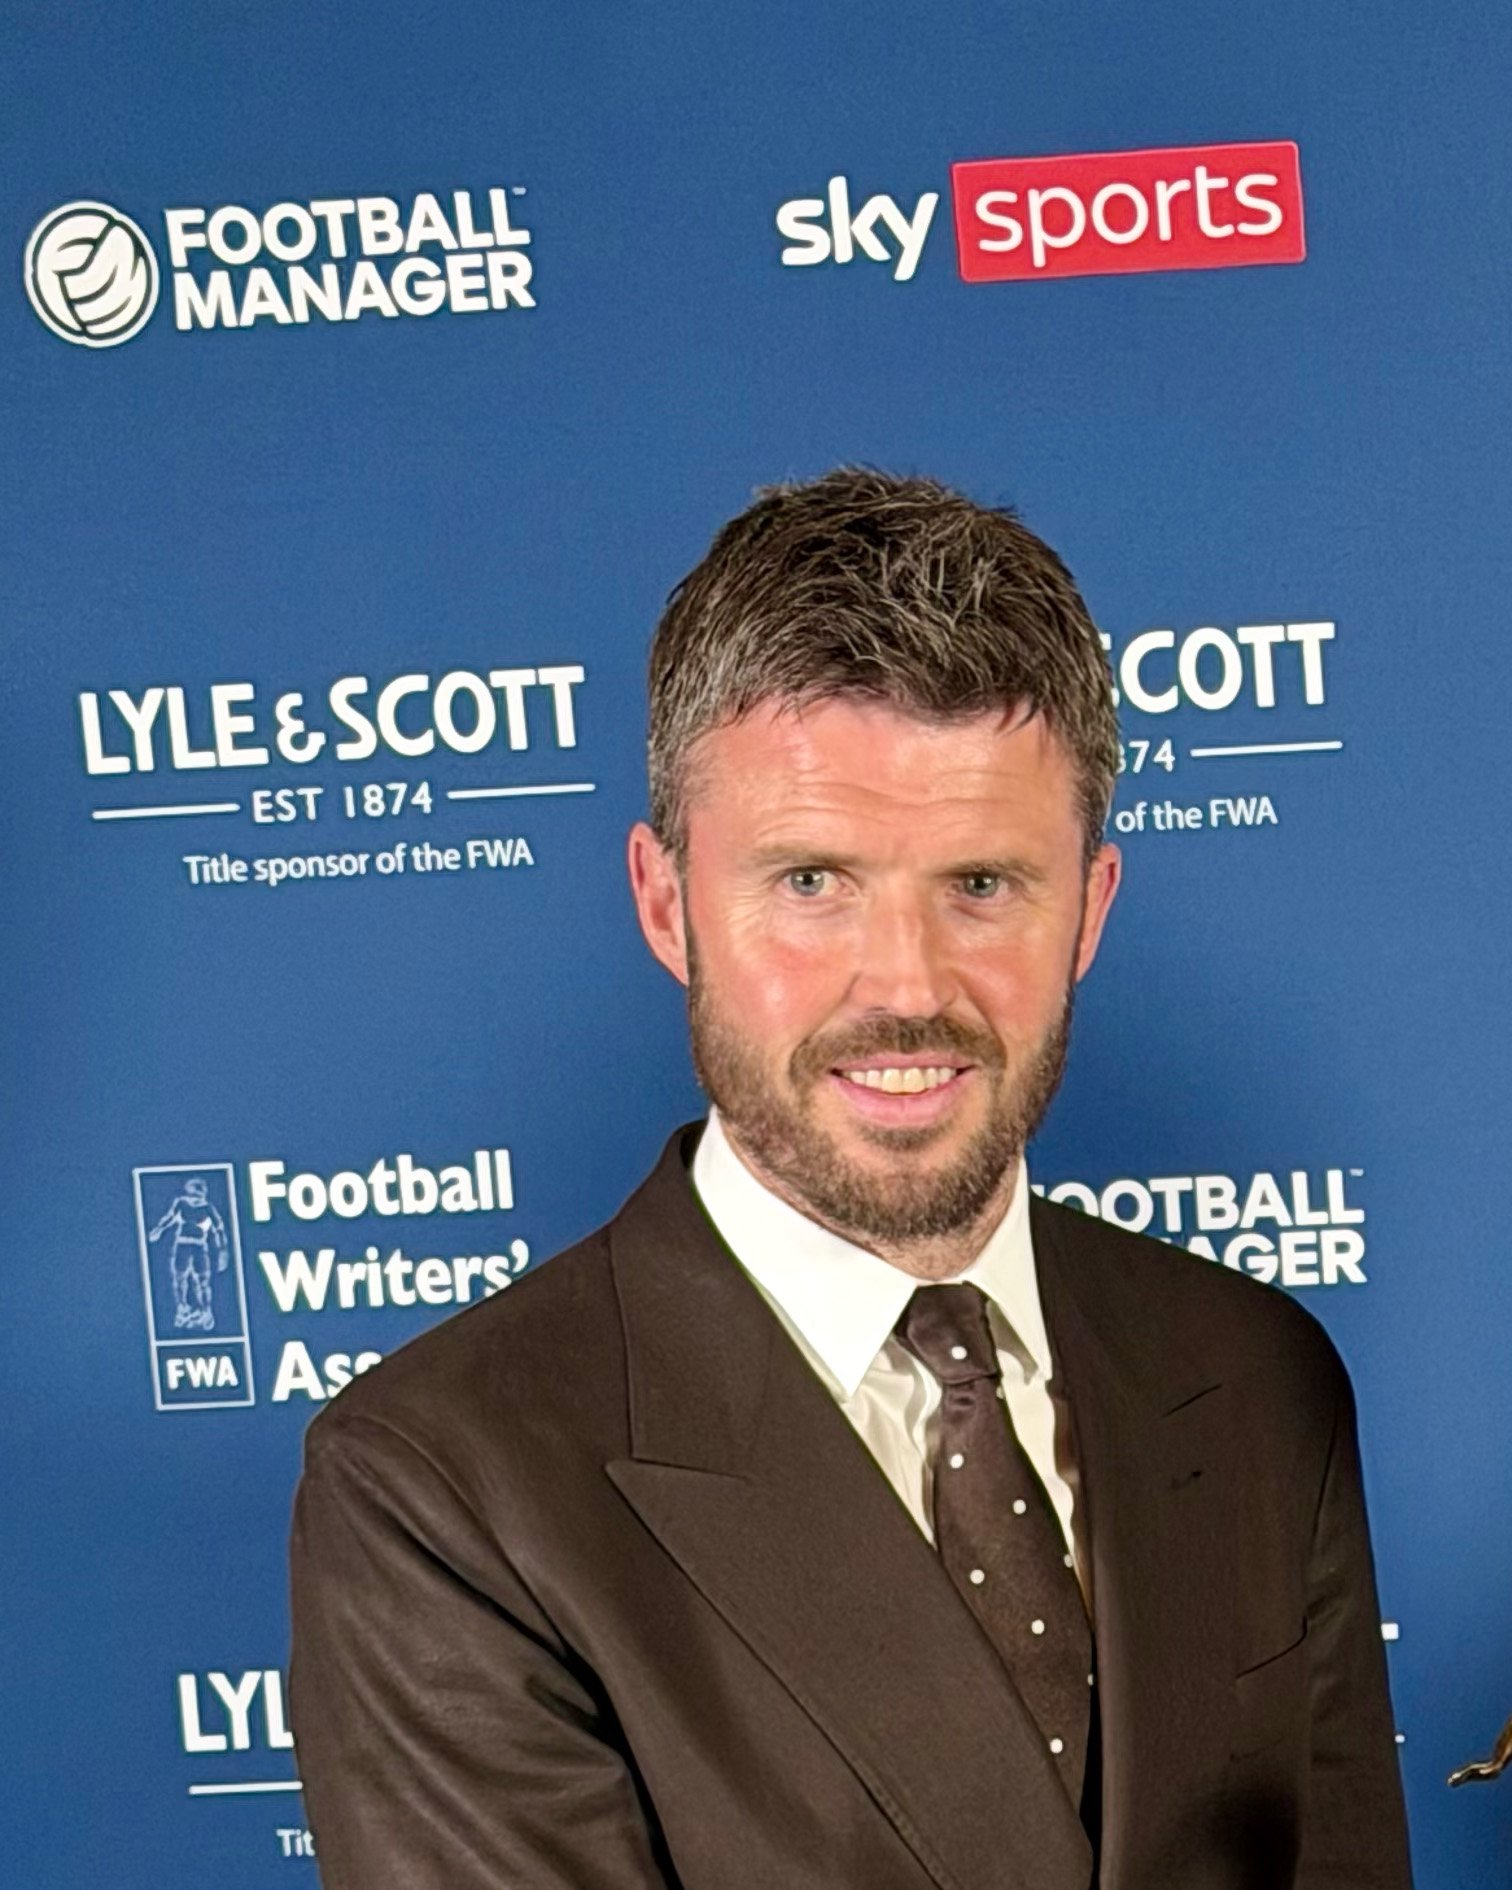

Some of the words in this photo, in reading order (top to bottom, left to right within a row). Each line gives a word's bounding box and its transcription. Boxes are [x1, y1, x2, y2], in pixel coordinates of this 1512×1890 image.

[164, 187, 532, 268] FOOTBALL
[776, 175, 939, 281] sky
[975, 165, 1283, 268] sports
[169, 251, 537, 331] MANAGER
[1099, 621, 1336, 714] COTT
[79, 683, 270, 775] LYLE
[329, 665, 585, 761] SCOTT
[252, 787, 324, 823] EST
[344, 781, 433, 818] 1874
[1115, 801, 1148, 833] of
[1152, 800, 1203, 831] the
[1209, 796, 1278, 827] FWA
[182, 853, 248, 884] Title
[253, 853, 370, 887] sponsor
[375, 842, 407, 874] of
[411, 842, 461, 872] the
[466, 837, 534, 869] FWA
[248, 1149, 514, 1222] Football
[1029, 1168, 1366, 1234] OTBALL
[166, 1355, 239, 1390] FWA
